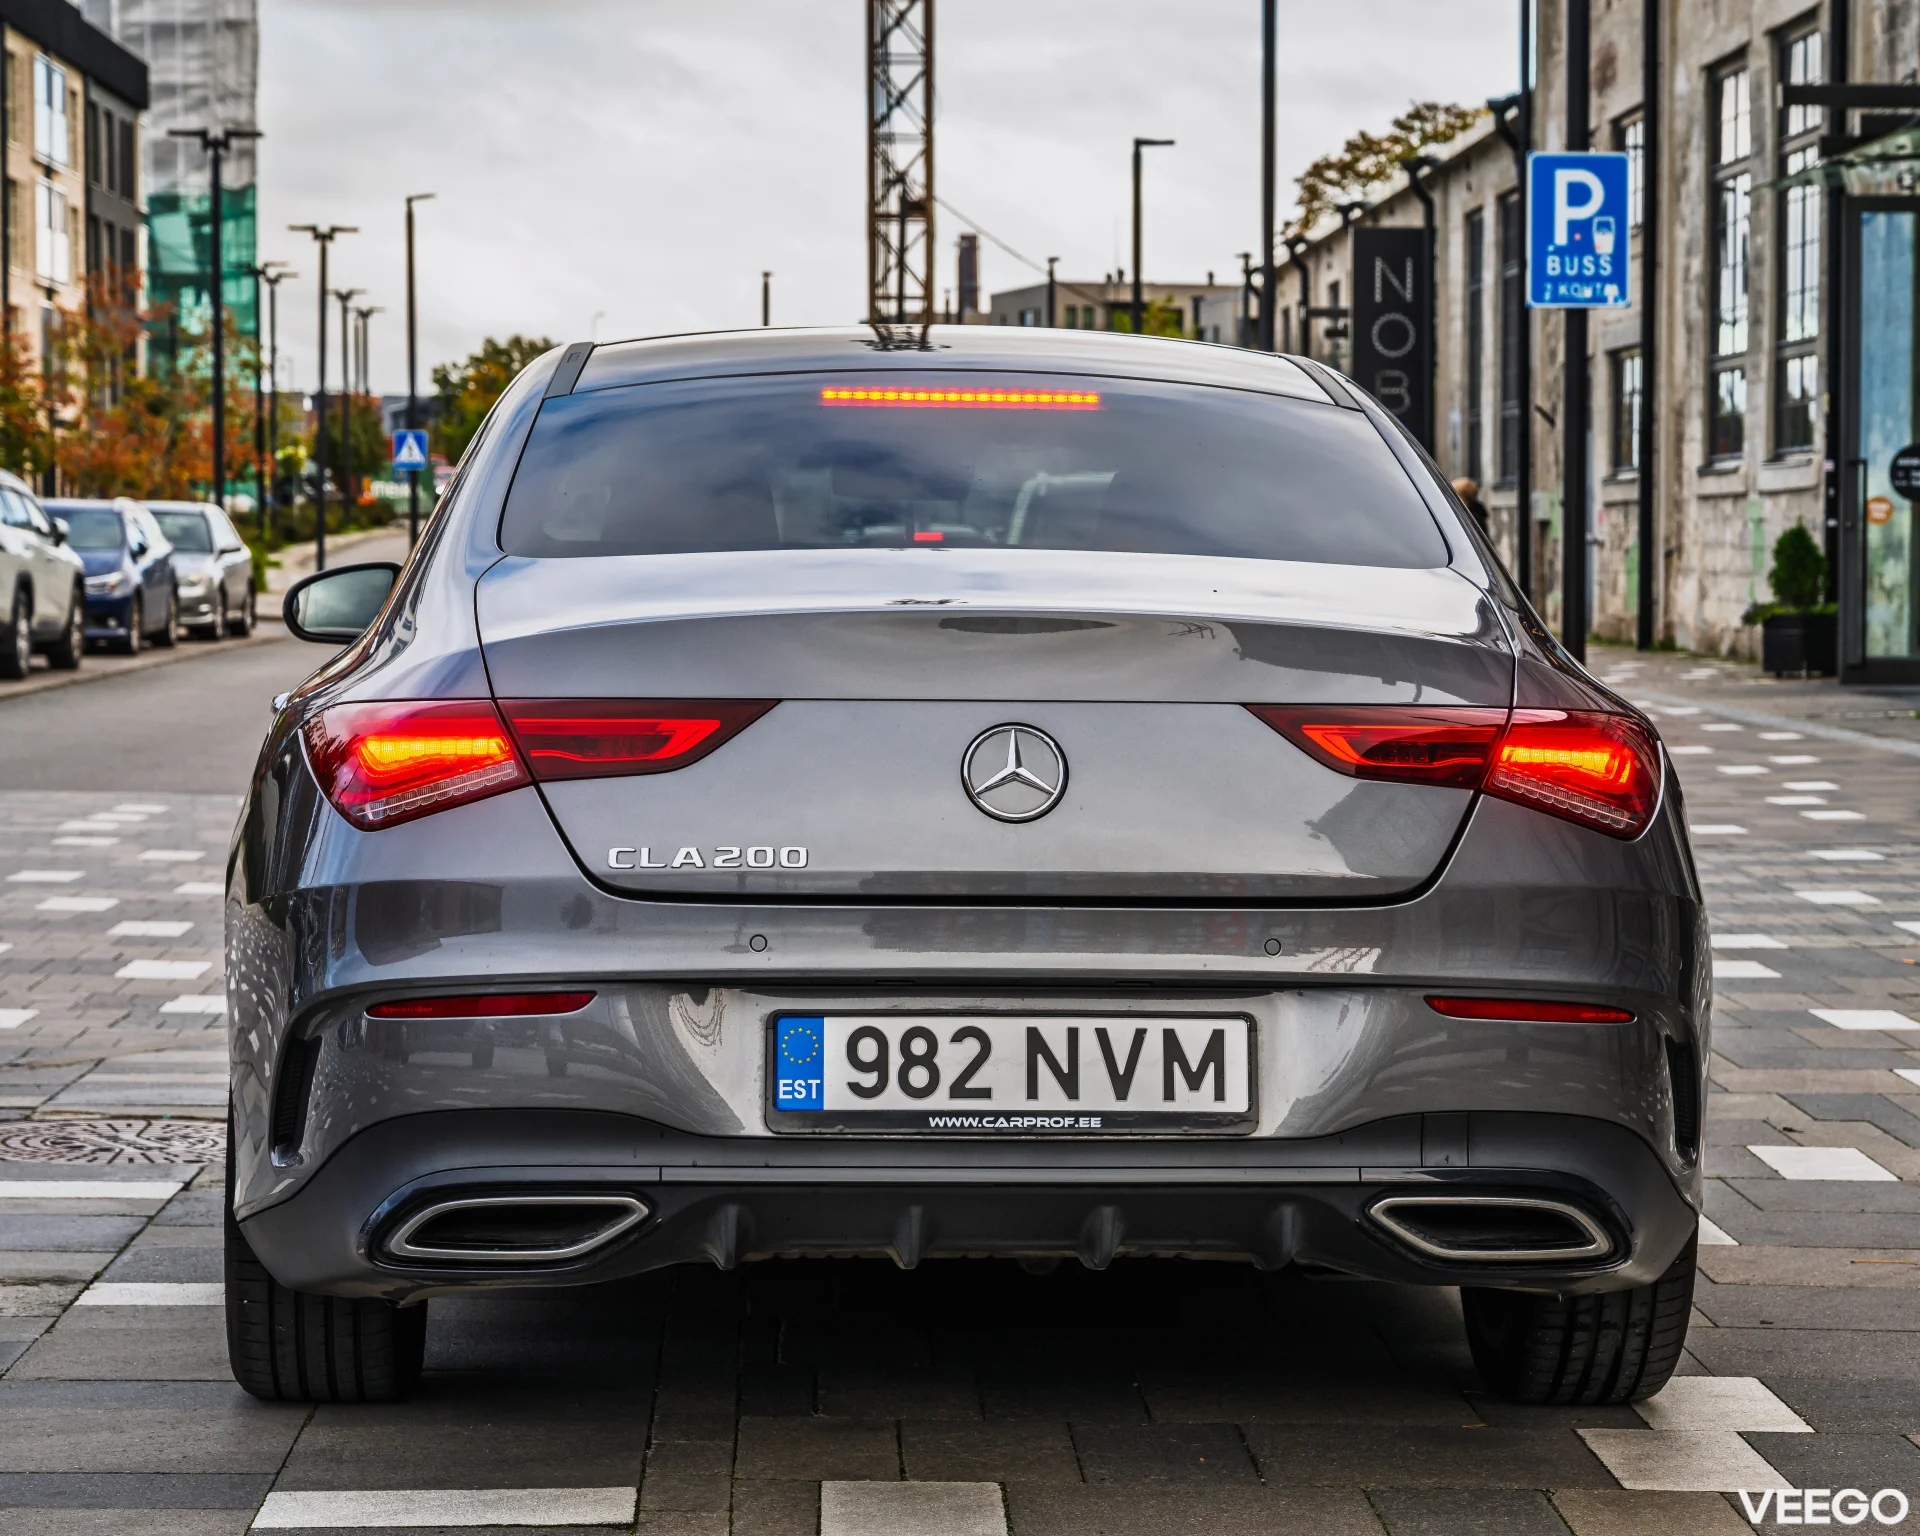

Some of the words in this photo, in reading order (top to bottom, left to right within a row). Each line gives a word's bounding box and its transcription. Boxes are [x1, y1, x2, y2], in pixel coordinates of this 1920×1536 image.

[1554, 168, 1605, 246] P
[1546, 254, 1612, 276] BUSS
[607, 847, 706, 869] CLA
[712, 846, 809, 869] 200
[845, 1025, 993, 1100] 982
[1025, 1026, 1227, 1102] NVM
[778, 1079, 821, 1100] EST
[928, 1116, 1102, 1128] WWW.CARPROF.EE
